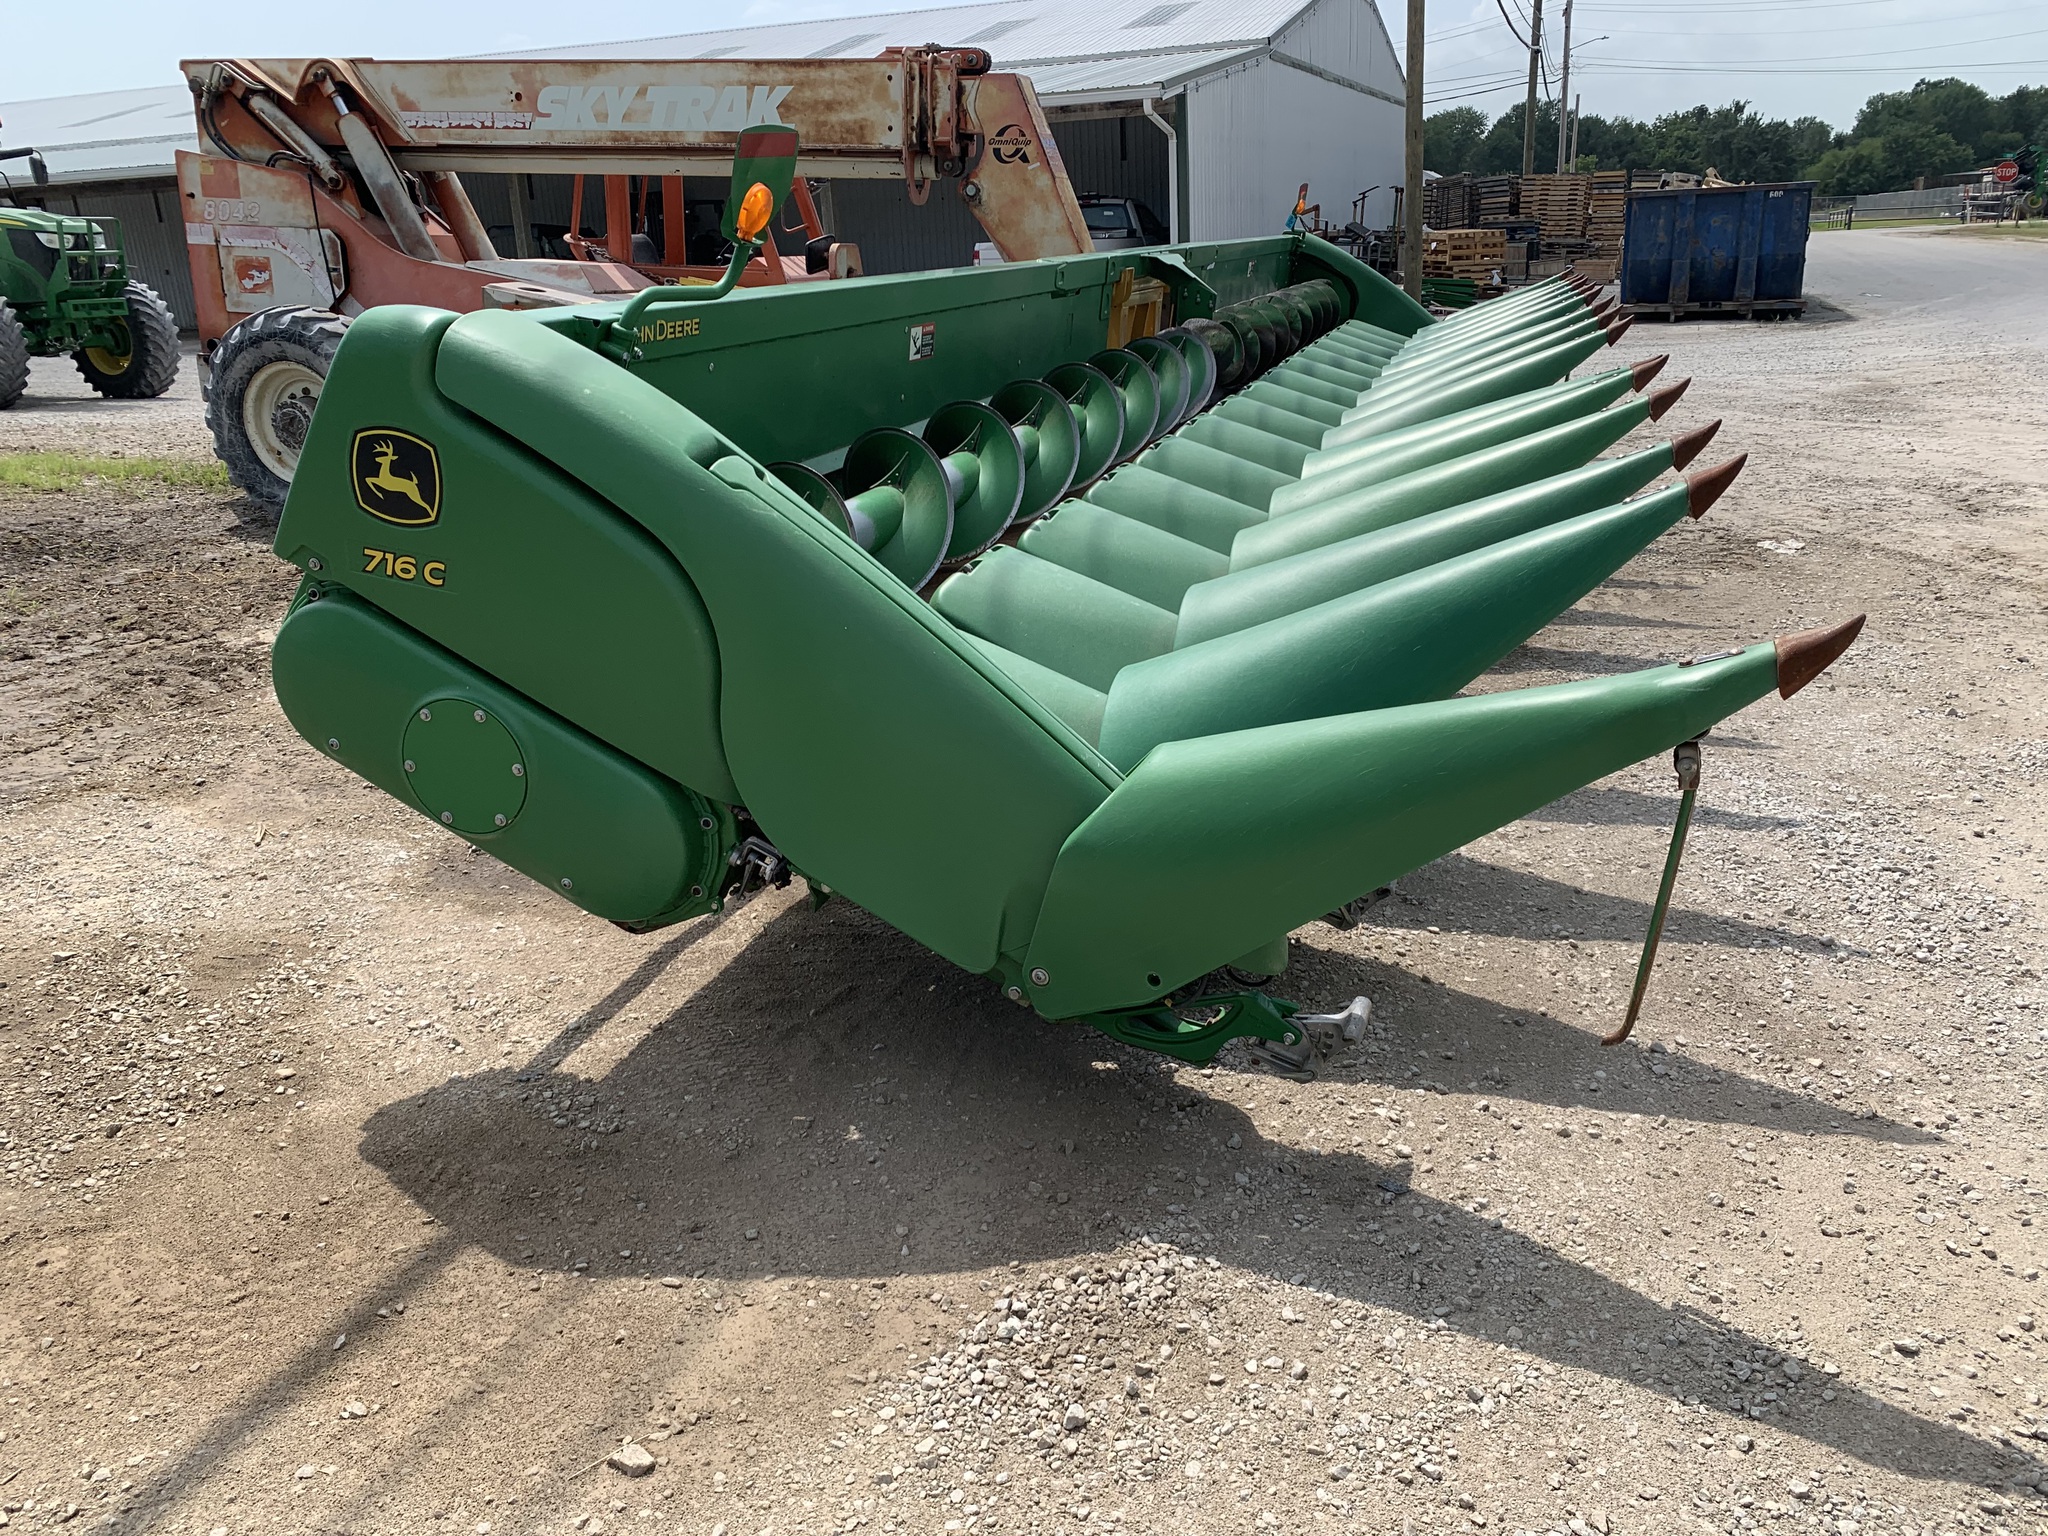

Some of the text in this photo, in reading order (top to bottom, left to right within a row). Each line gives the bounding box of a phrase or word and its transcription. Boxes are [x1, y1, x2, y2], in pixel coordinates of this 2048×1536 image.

[988, 137, 1032, 147] OmniQuip
[1996, 167, 2017, 177] STOP
[203, 200, 260, 223] 8042
[656, 318, 700, 341] DEERE
[362, 547, 447, 587] 716 C
